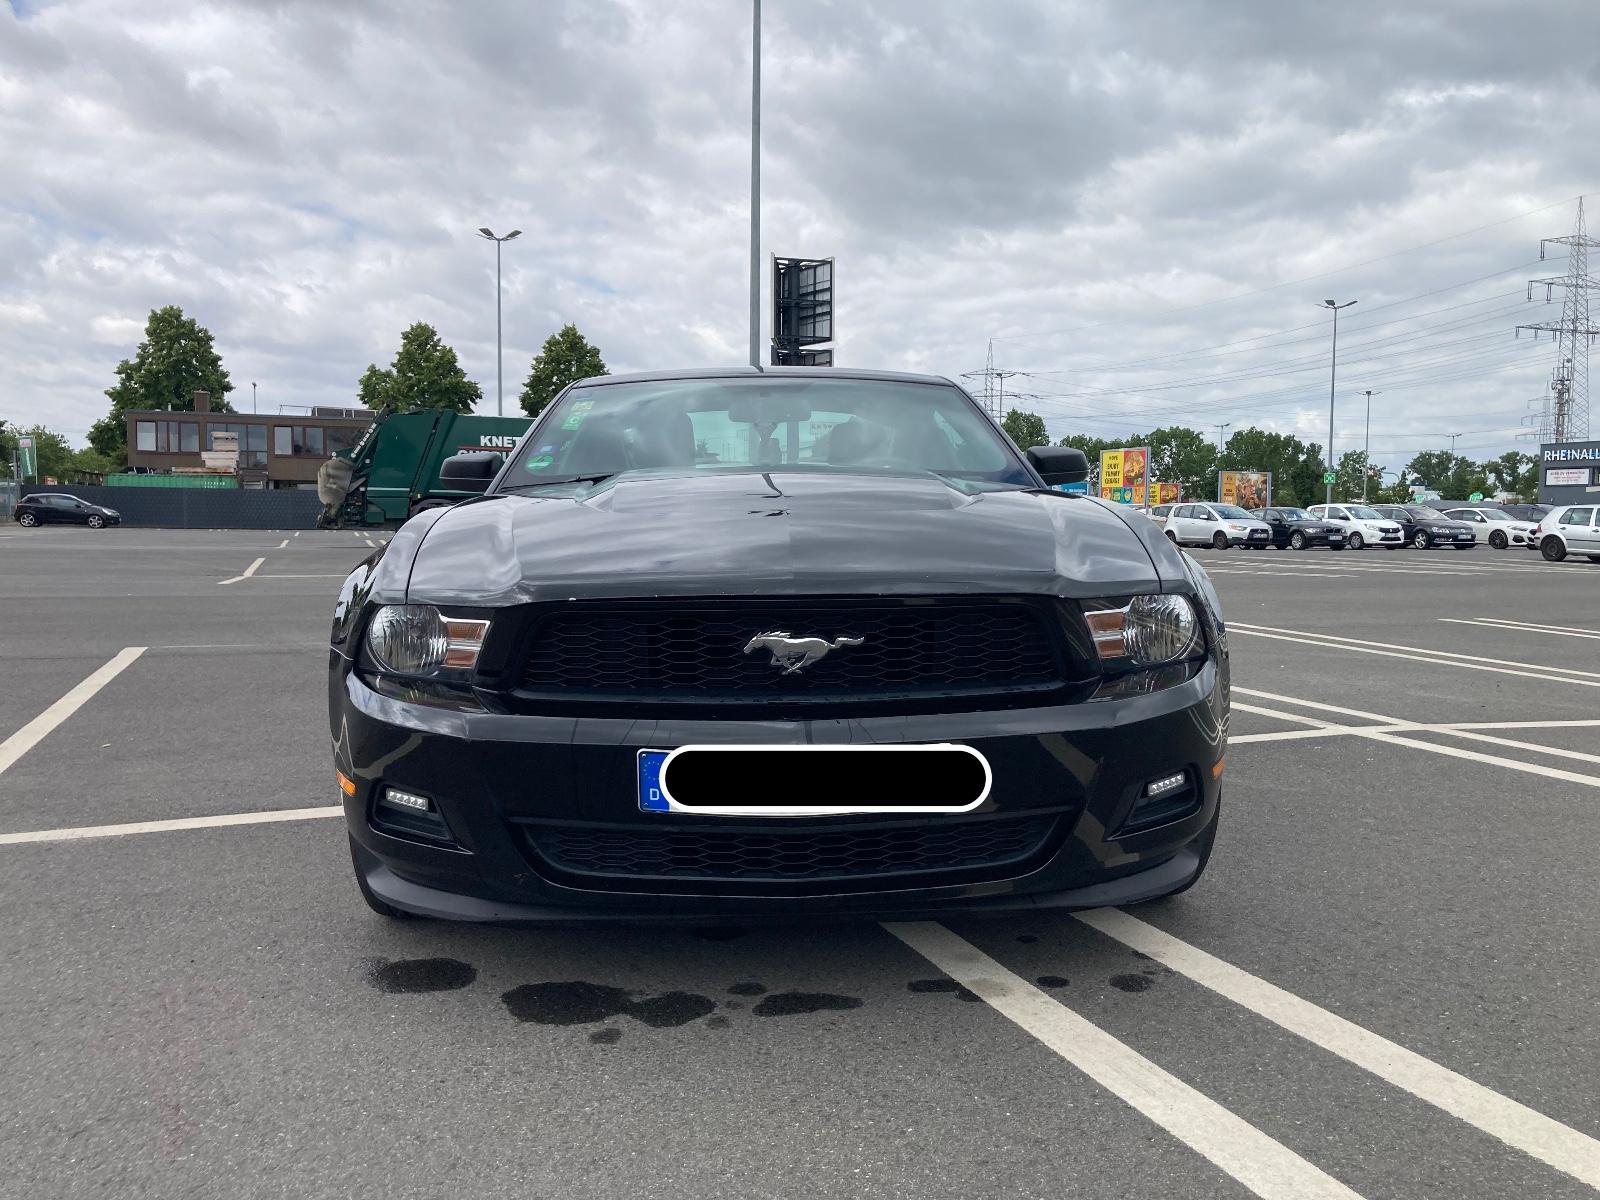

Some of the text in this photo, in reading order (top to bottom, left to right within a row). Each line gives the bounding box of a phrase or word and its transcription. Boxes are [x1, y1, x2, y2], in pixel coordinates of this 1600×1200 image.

[480, 435, 523, 447] KNET
[1544, 448, 1600, 461] RHEINALL
[649, 788, 660, 801] D
